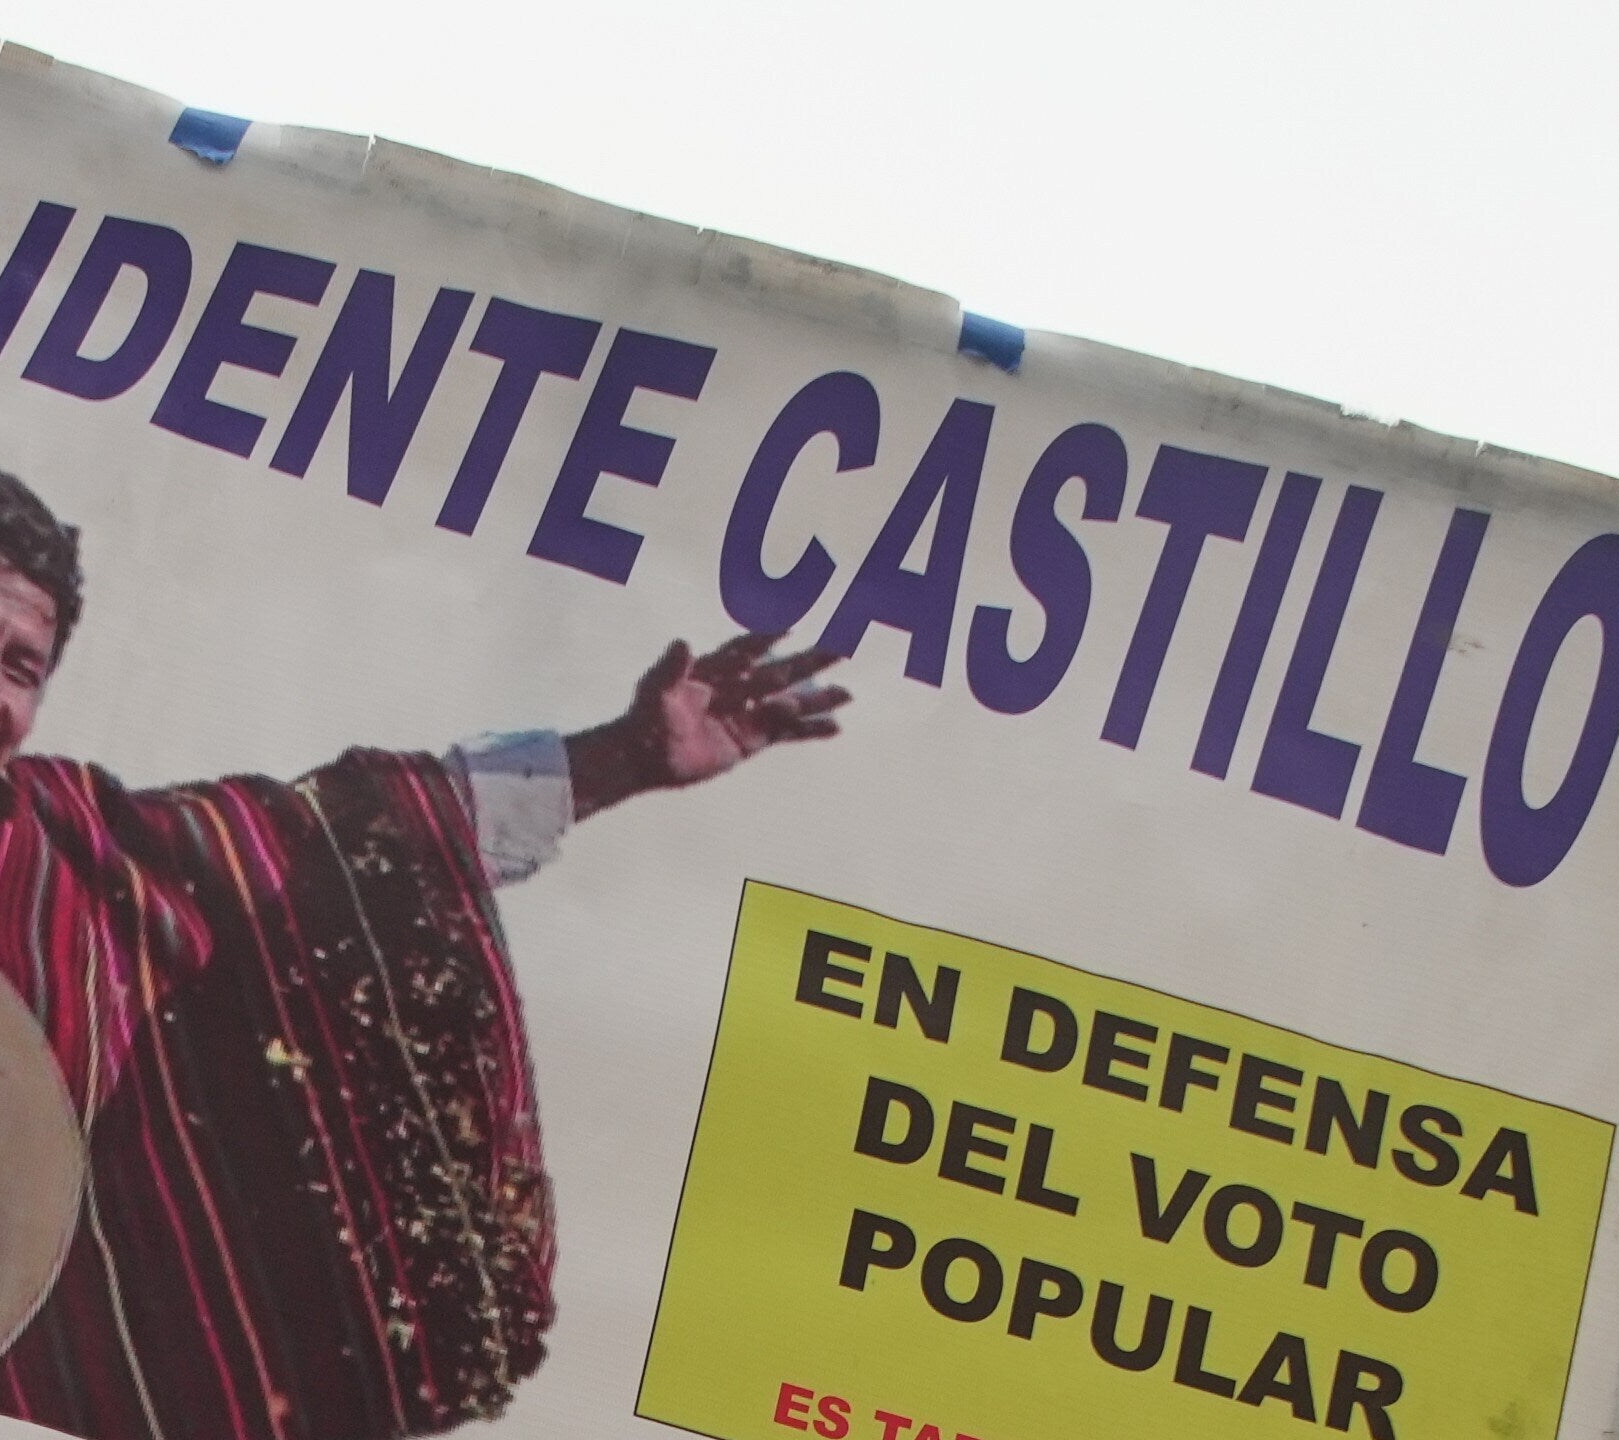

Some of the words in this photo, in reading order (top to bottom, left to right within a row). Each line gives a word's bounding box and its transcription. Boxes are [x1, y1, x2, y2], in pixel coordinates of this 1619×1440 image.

[794, 928, 963, 1045] EN
[999, 984, 1540, 1218] DEFENSA
[852, 1074, 1081, 1218] DEL
[1129, 1151, 1440, 1315] VOTO
[774, 1382, 852, 1440] ES
